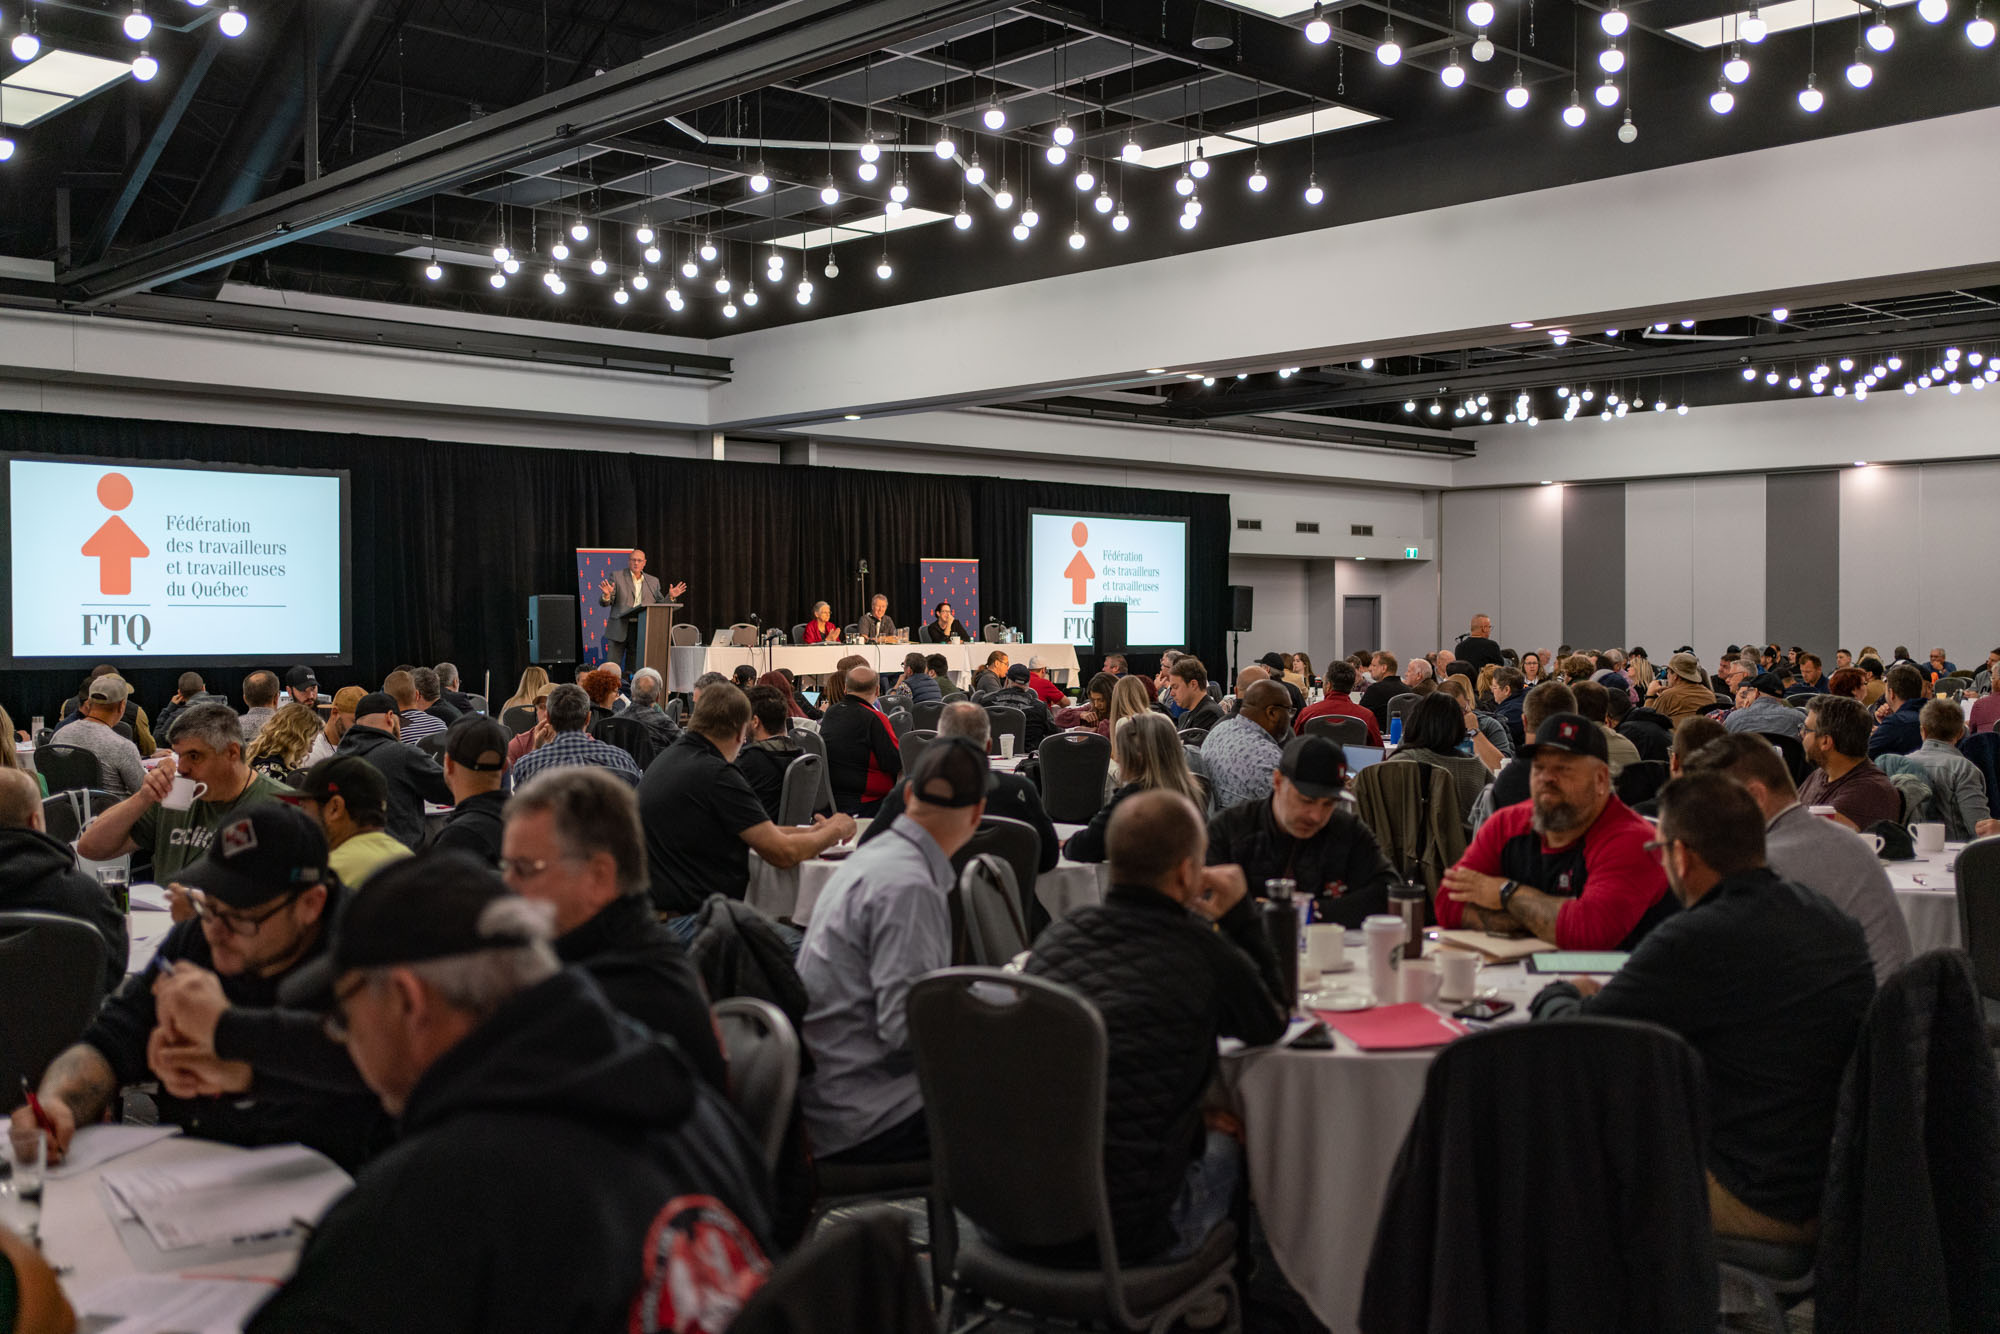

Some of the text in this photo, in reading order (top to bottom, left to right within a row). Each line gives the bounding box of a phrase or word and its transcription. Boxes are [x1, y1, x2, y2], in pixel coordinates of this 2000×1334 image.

[166, 515, 250, 533] Fédération
[166, 537, 287, 556] des travailleurs
[1103, 549, 1143, 562] Fédération
[166, 561, 286, 577] et travailleuses
[1102, 565, 1160, 577] des travailleurs
[166, 581, 249, 599] du Québec
[1102, 581, 1160, 592] et travailleuses
[81, 614, 151, 651] FTQ
[1064, 617, 1095, 643] FTQ
